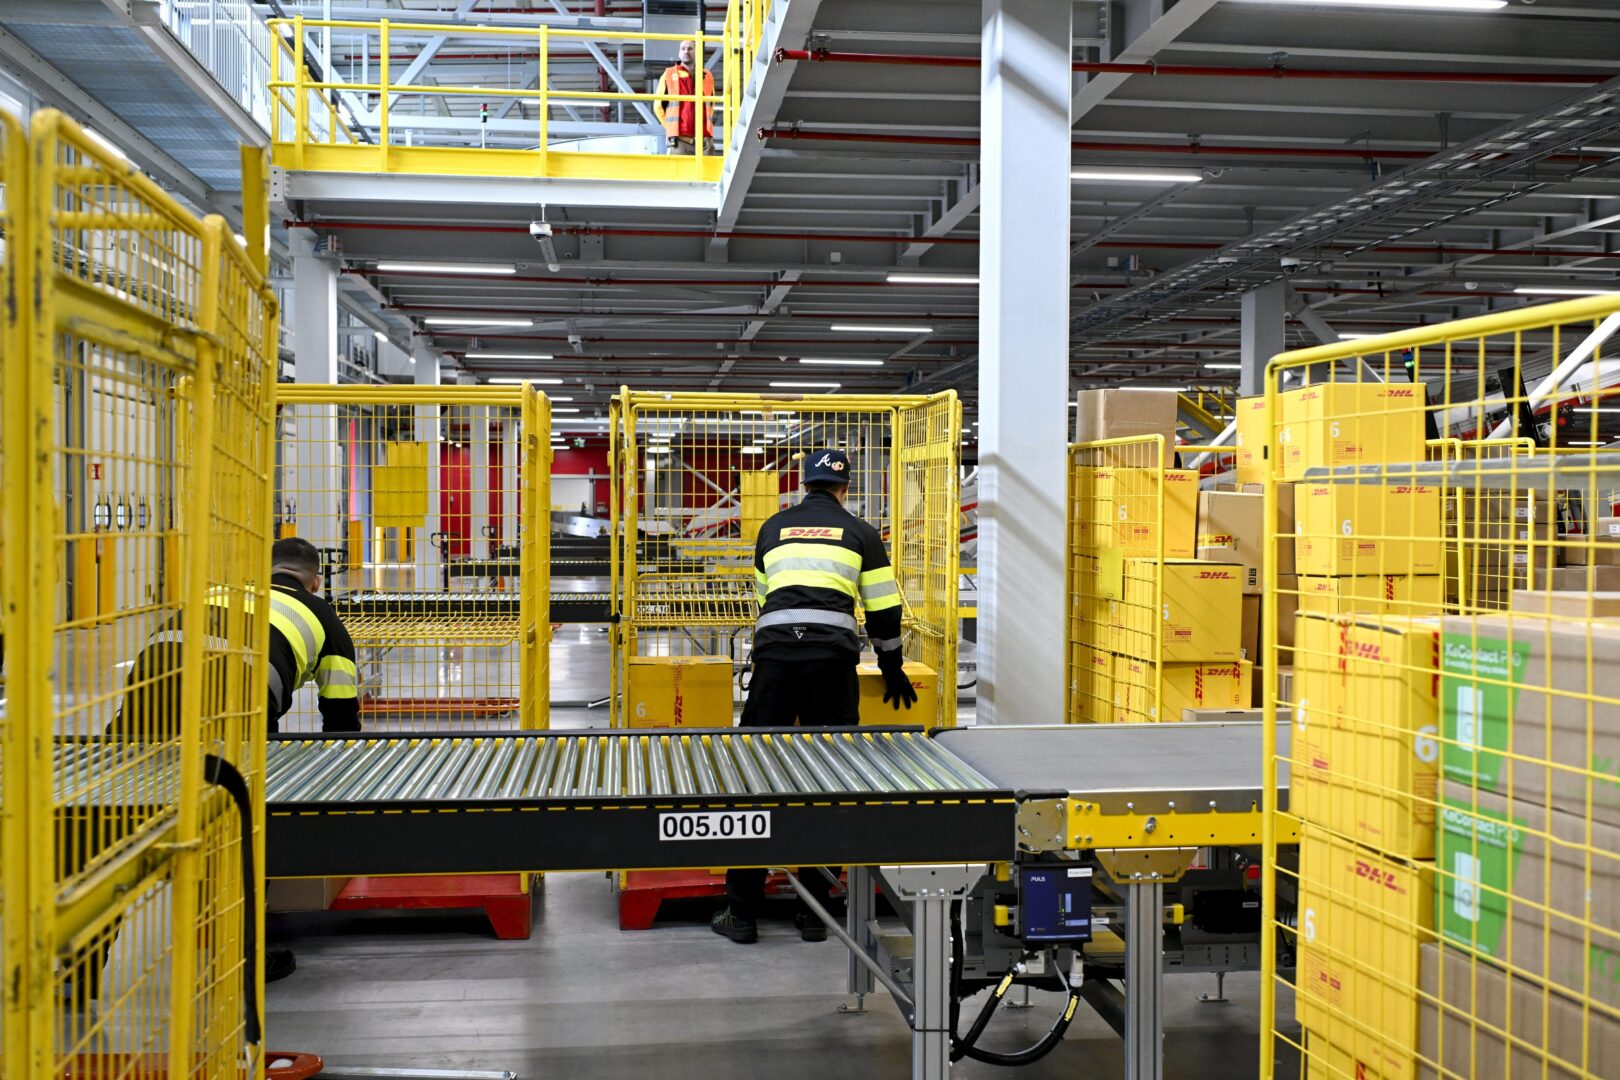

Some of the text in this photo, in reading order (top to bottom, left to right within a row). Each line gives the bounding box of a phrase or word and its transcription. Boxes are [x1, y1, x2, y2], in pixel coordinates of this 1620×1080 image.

[1330, 421, 1340, 438] 6
[788, 528, 833, 537] DHL
[1341, 519, 1352, 536] 6
[1200, 571, 1231, 579] DHL
[1194, 667, 1203, 699] DHL
[635, 702, 647, 718] 6
[674, 695, 683, 726] DHL
[1414, 725, 1439, 763] 6
[663, 814, 767, 838] 005.010
[1355, 860, 1398, 891] DHL
[1304, 908, 1316, 943] 6
